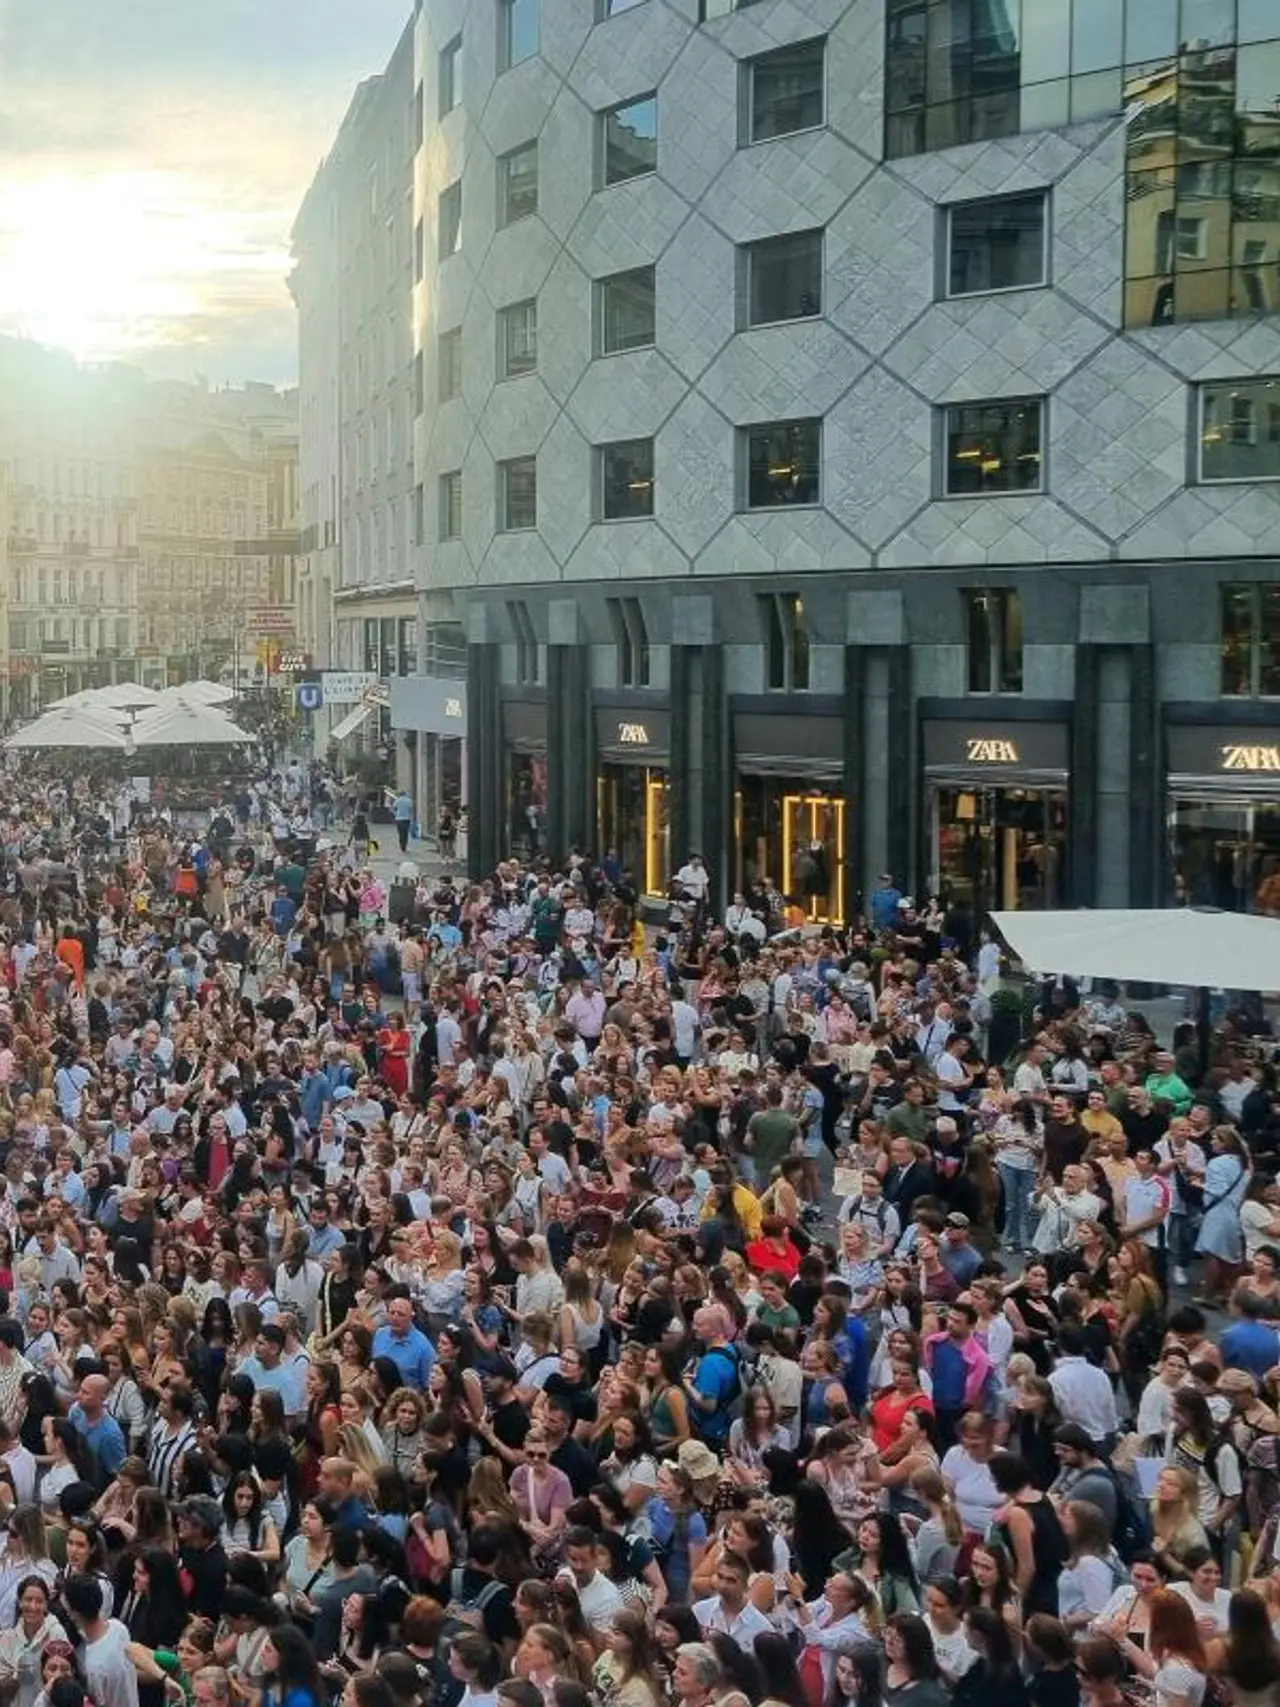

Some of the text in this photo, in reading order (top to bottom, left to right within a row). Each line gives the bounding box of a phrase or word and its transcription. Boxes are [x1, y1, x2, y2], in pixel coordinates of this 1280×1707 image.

[301, 689, 317, 707] U
[618, 722, 649, 744] ZARA
[966, 739, 1019, 761] ZARA
[1221, 746, 1280, 770] ZARA
